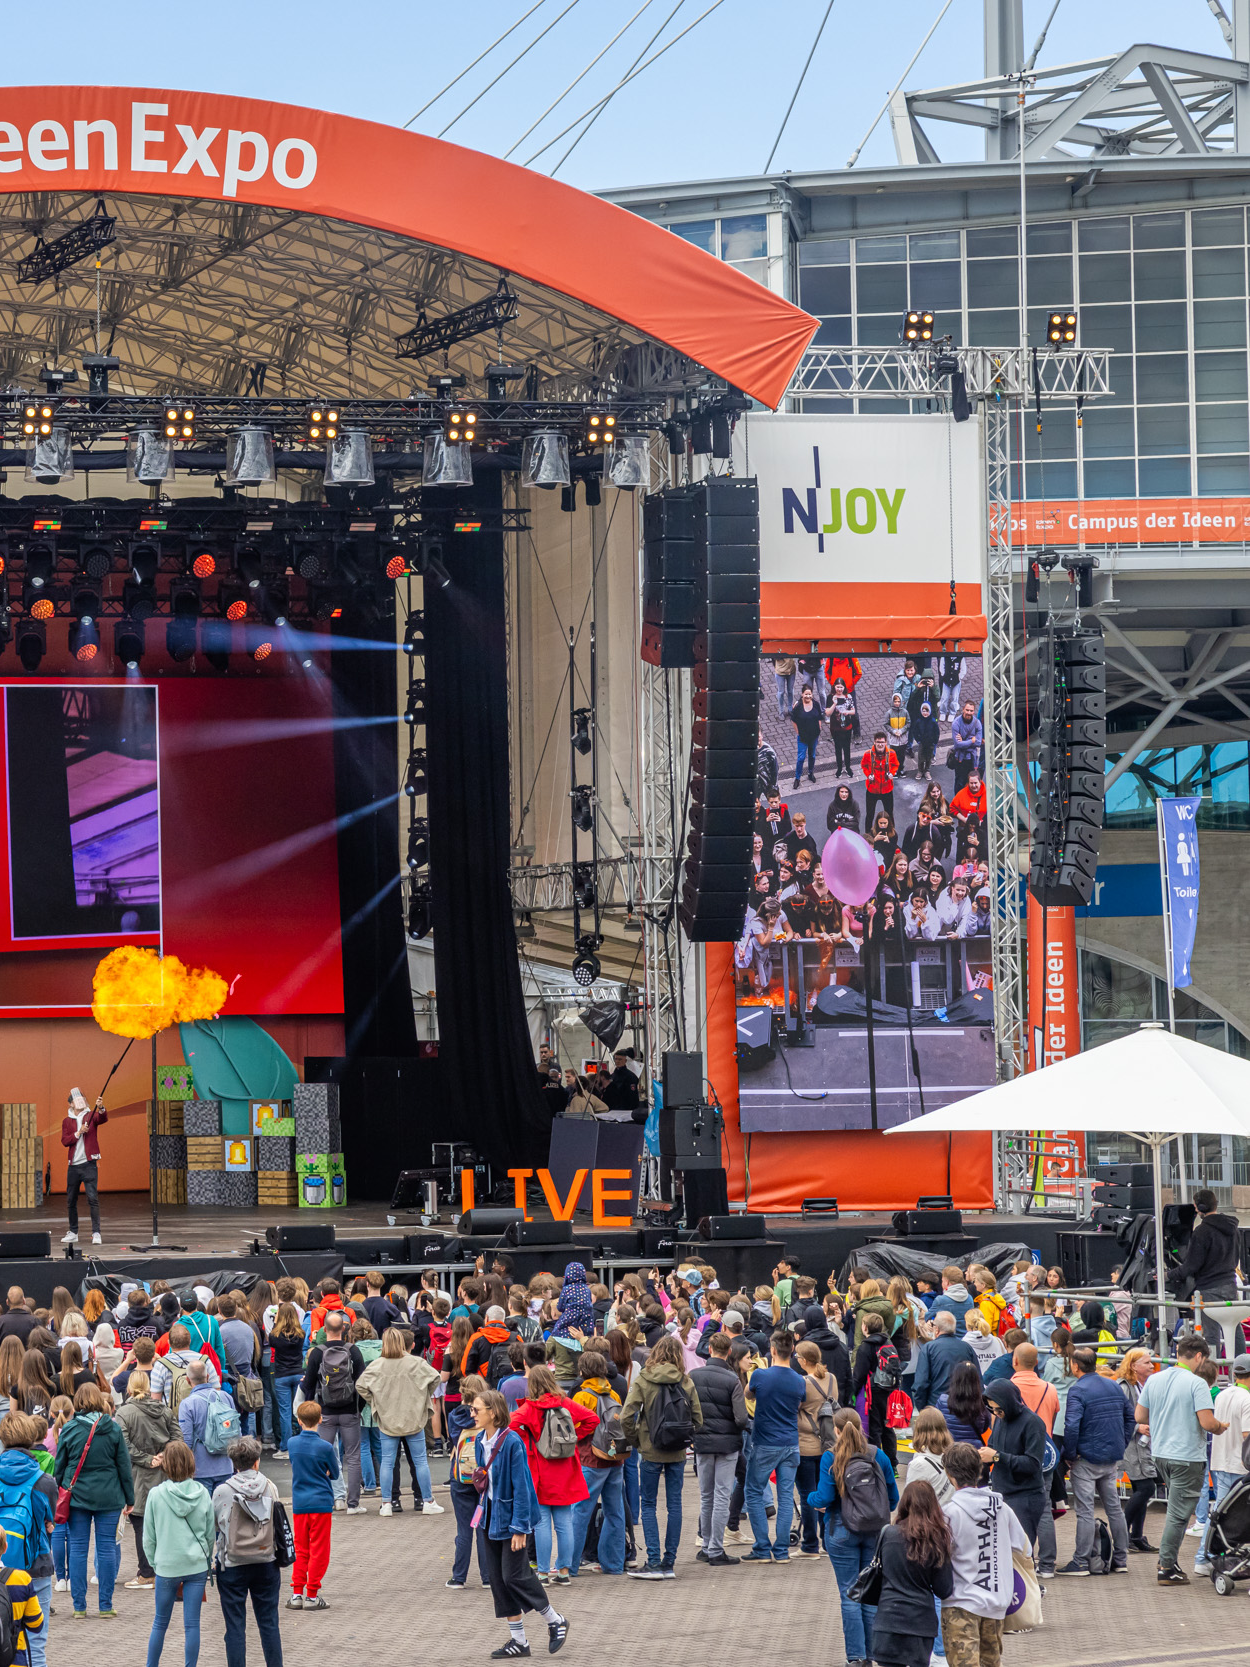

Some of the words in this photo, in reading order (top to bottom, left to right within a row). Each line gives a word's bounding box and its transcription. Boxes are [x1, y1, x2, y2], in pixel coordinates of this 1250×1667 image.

[1068, 513, 1139, 532] Campus
[1145, 512, 1177, 528] der
[1182, 511, 1236, 528] Ideen
[1175, 805, 1194, 820] WC
[1045, 941, 1066, 1014] Ideen
[1045, 1023, 1066, 1067] der
[972, 1520, 992, 1592] ALPHA
